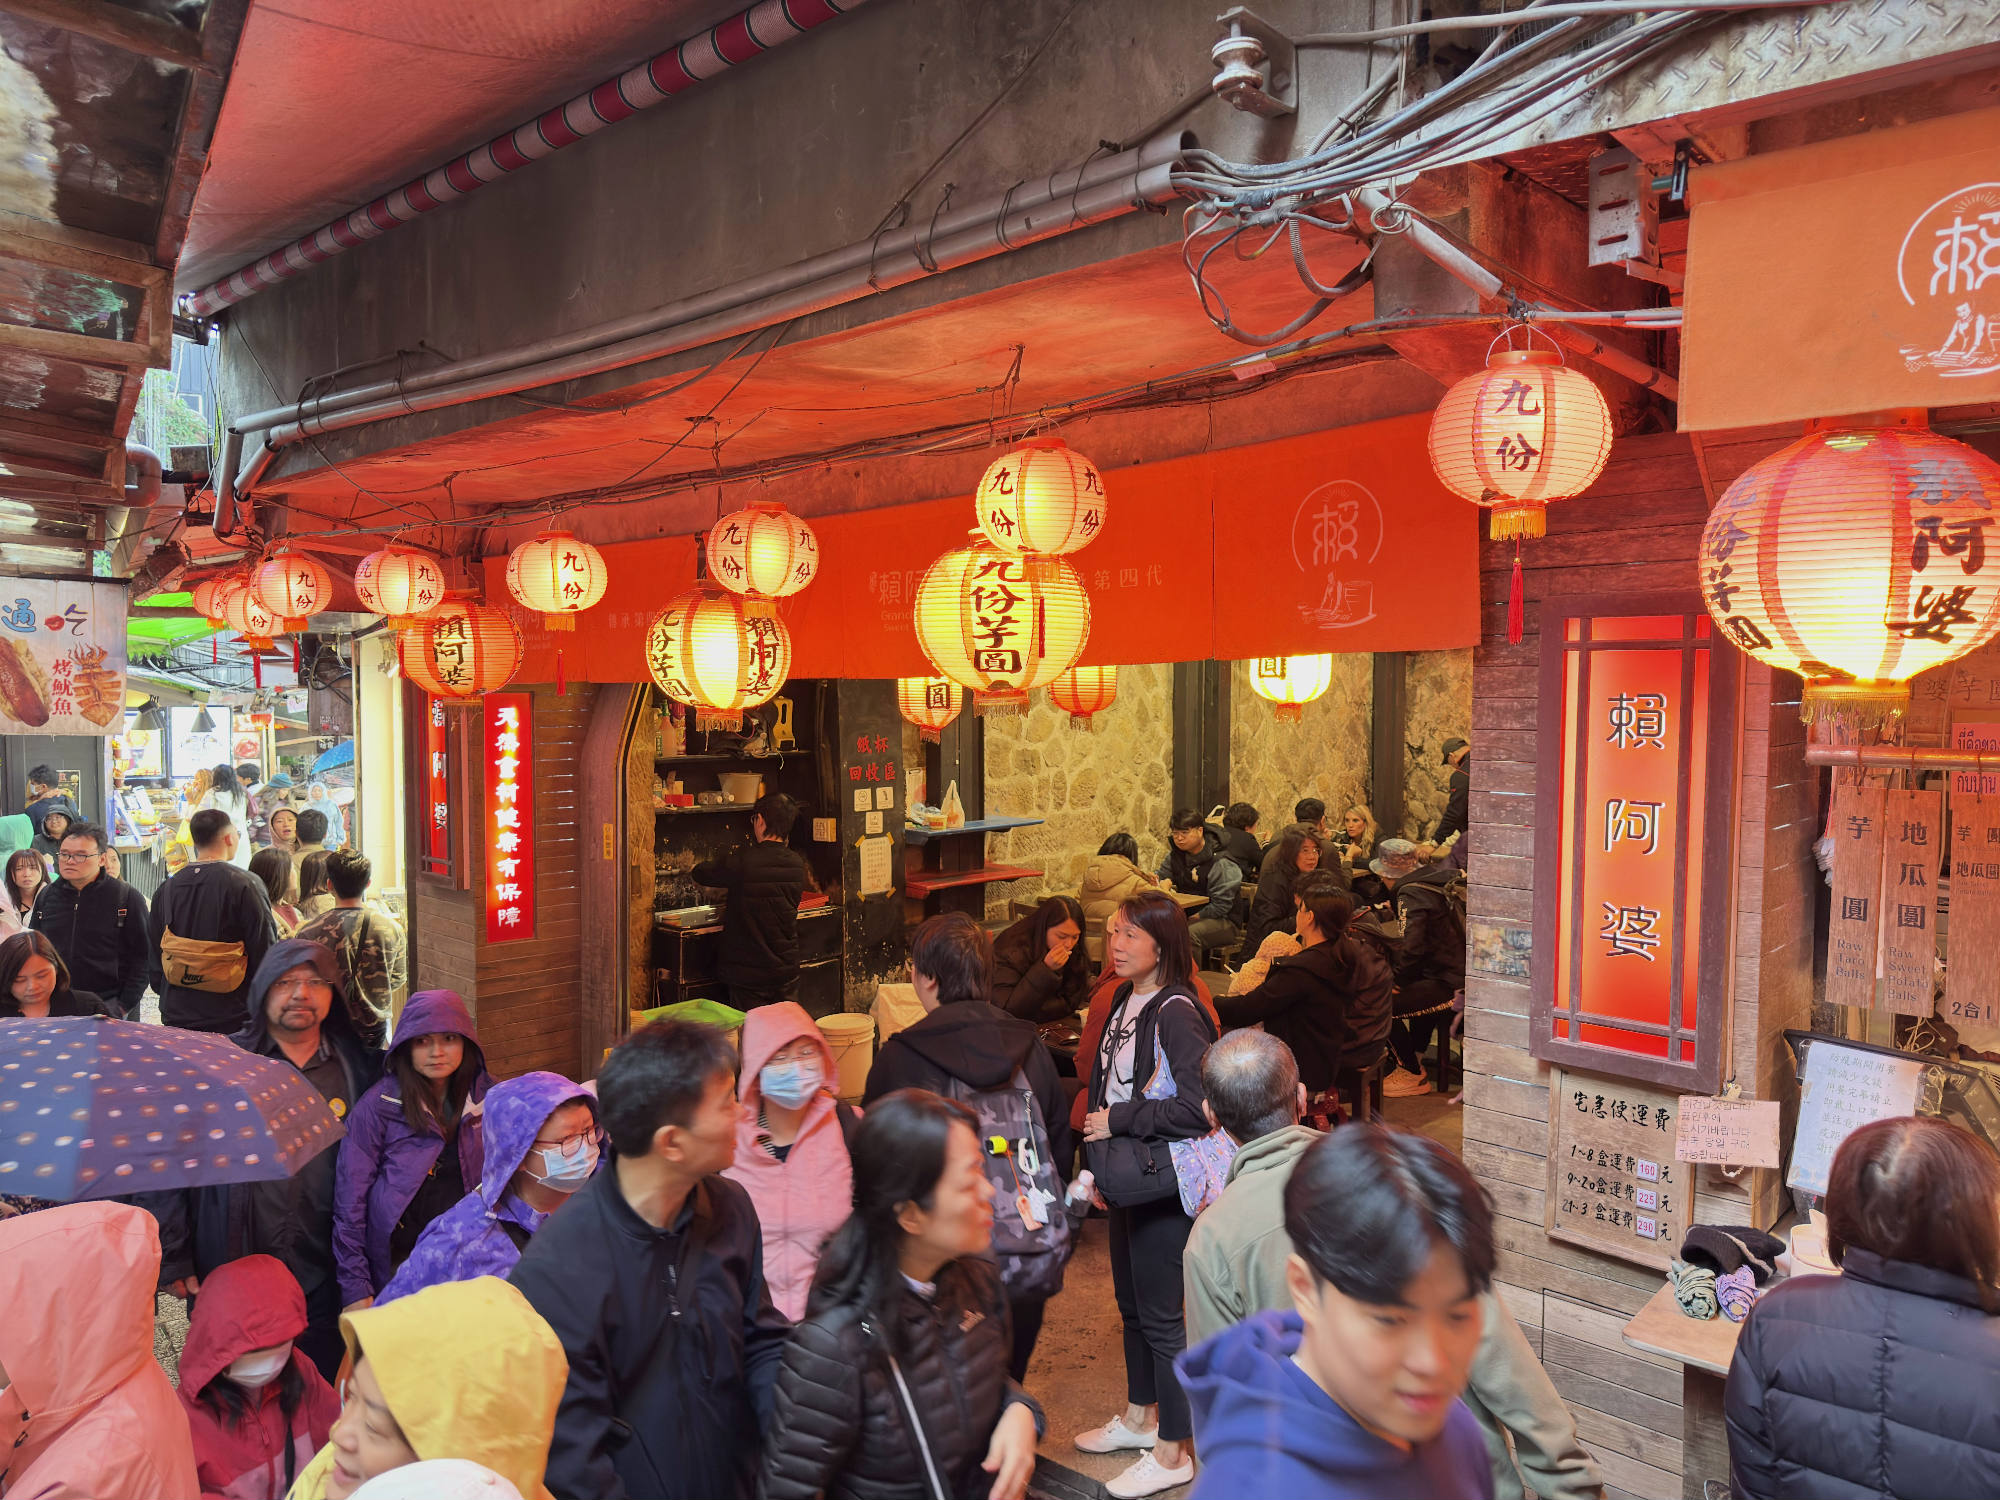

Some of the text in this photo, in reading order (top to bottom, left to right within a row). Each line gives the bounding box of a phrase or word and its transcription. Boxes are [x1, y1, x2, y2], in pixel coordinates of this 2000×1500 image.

[1495, 379, 1541, 471] 九份
[989, 467, 1015, 537] 九份
[1080, 467, 1103, 537] 九份
[721, 523, 744, 580] 九份
[793, 529, 815, 584] 九份
[1886, 459, 1996, 643] 賴阿婆
[296, 572, 314, 609] 九份
[418, 565, 435, 605] 九份
[562, 551, 585, 599] 九份
[969, 561, 1027, 674] 九份芋圓
[433, 614, 473, 686] 賴阿婆
[651, 610, 693, 697] 九份芋圓
[737, 616, 780, 696] 賴阿婆
[51, 659, 74, 716] 烤魷魚
[926, 683, 950, 710] 圓
[857, 734, 889, 755] 紙杯
[849, 762, 896, 781] 回收區
[1600, 692, 1667, 963] 賴阿婆
[1842, 815, 1873, 922] 芋圓
[1897, 820, 1929, 929] 地瓜圓
[1956, 861, 2000, 880] 地瓜圓
[1837, 939, 1863, 952] Raw
[1889, 947, 1914, 959] Raw
[1835, 967, 1865, 980] Balls
[1887, 975, 1929, 990] Potato
[1888, 961, 1926, 975] Sweet
[1887, 988, 1918, 1002] Balls
[1573, 1090, 1671, 1133] 宅急便運費
[1639, 1164, 1655, 1177] 160
[1661, 1165, 1672, 1184] 元
[1638, 1193, 1655, 1205] 225
[1660, 1195, 1672, 1213] 元
[1638, 1221, 1654, 1233] 290
[1660, 1223, 1672, 1241] 元
